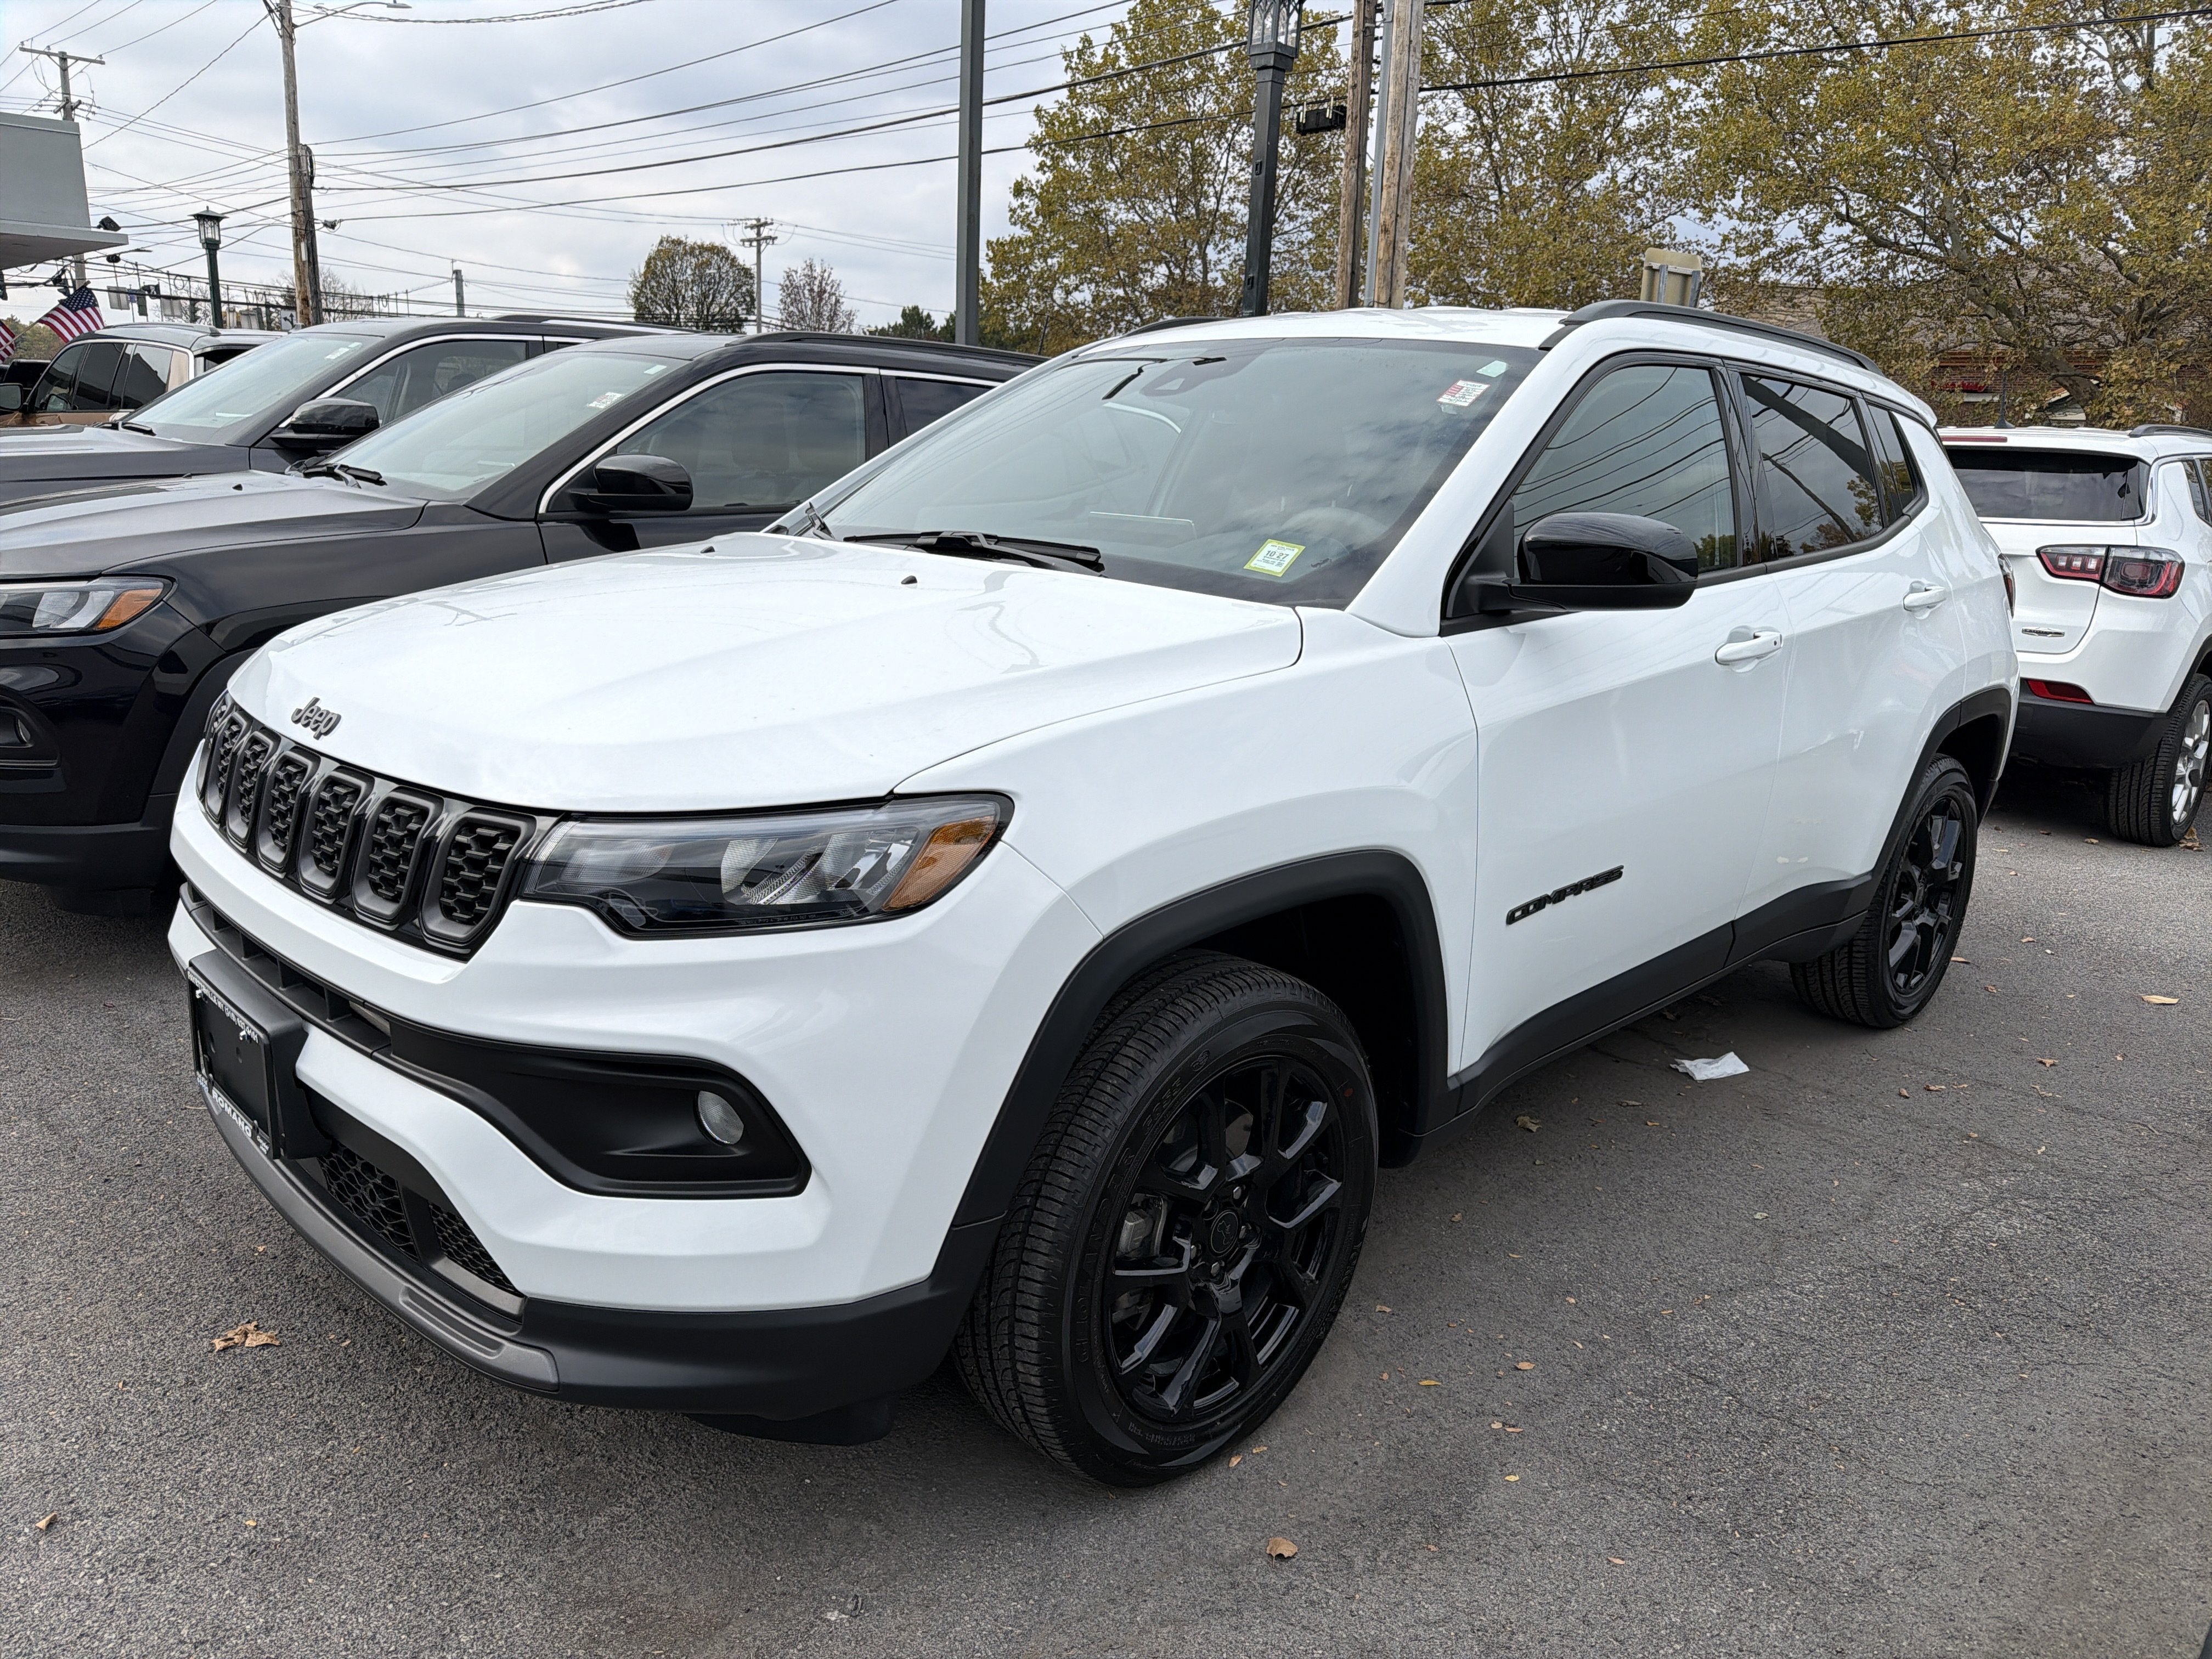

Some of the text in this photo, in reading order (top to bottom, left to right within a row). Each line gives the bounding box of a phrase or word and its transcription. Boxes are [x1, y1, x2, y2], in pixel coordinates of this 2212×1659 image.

[291, 697, 341, 741] Jeep
[1505, 865, 1624, 926] COMPASS
[212, 1089, 252, 1138] ROMANO
